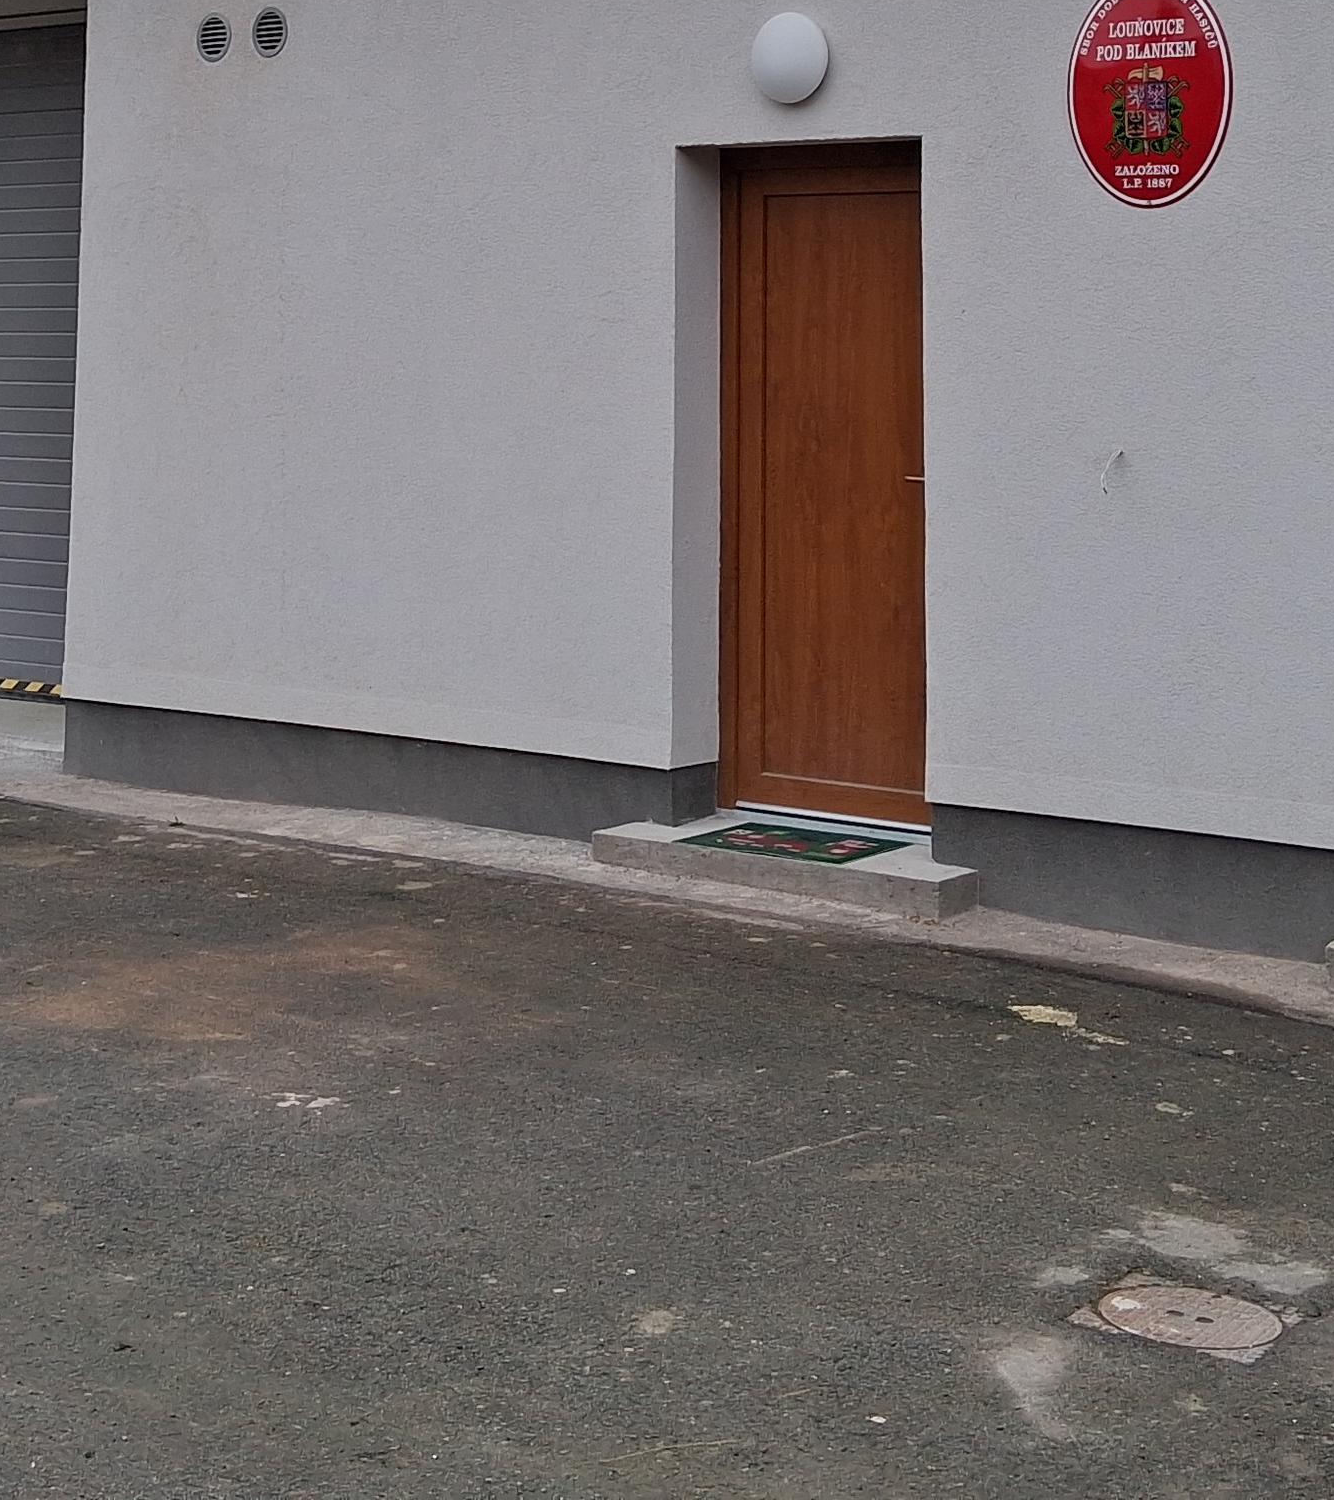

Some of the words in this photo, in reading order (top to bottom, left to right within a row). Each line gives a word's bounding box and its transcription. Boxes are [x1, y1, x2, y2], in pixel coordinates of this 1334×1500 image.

[1080, 22, 1100, 56] SBOR
[1188, 2, 1218, 49] HASIČŮ
[1108, 17, 1185, 38] LOUŇOVICE
[1096, 44, 1123, 62] POD
[1125, 37, 1197, 60] BLANÍKEM
[1114, 162, 1180, 177] ZALOŽENO
[1146, 178, 1173, 189] 1887
